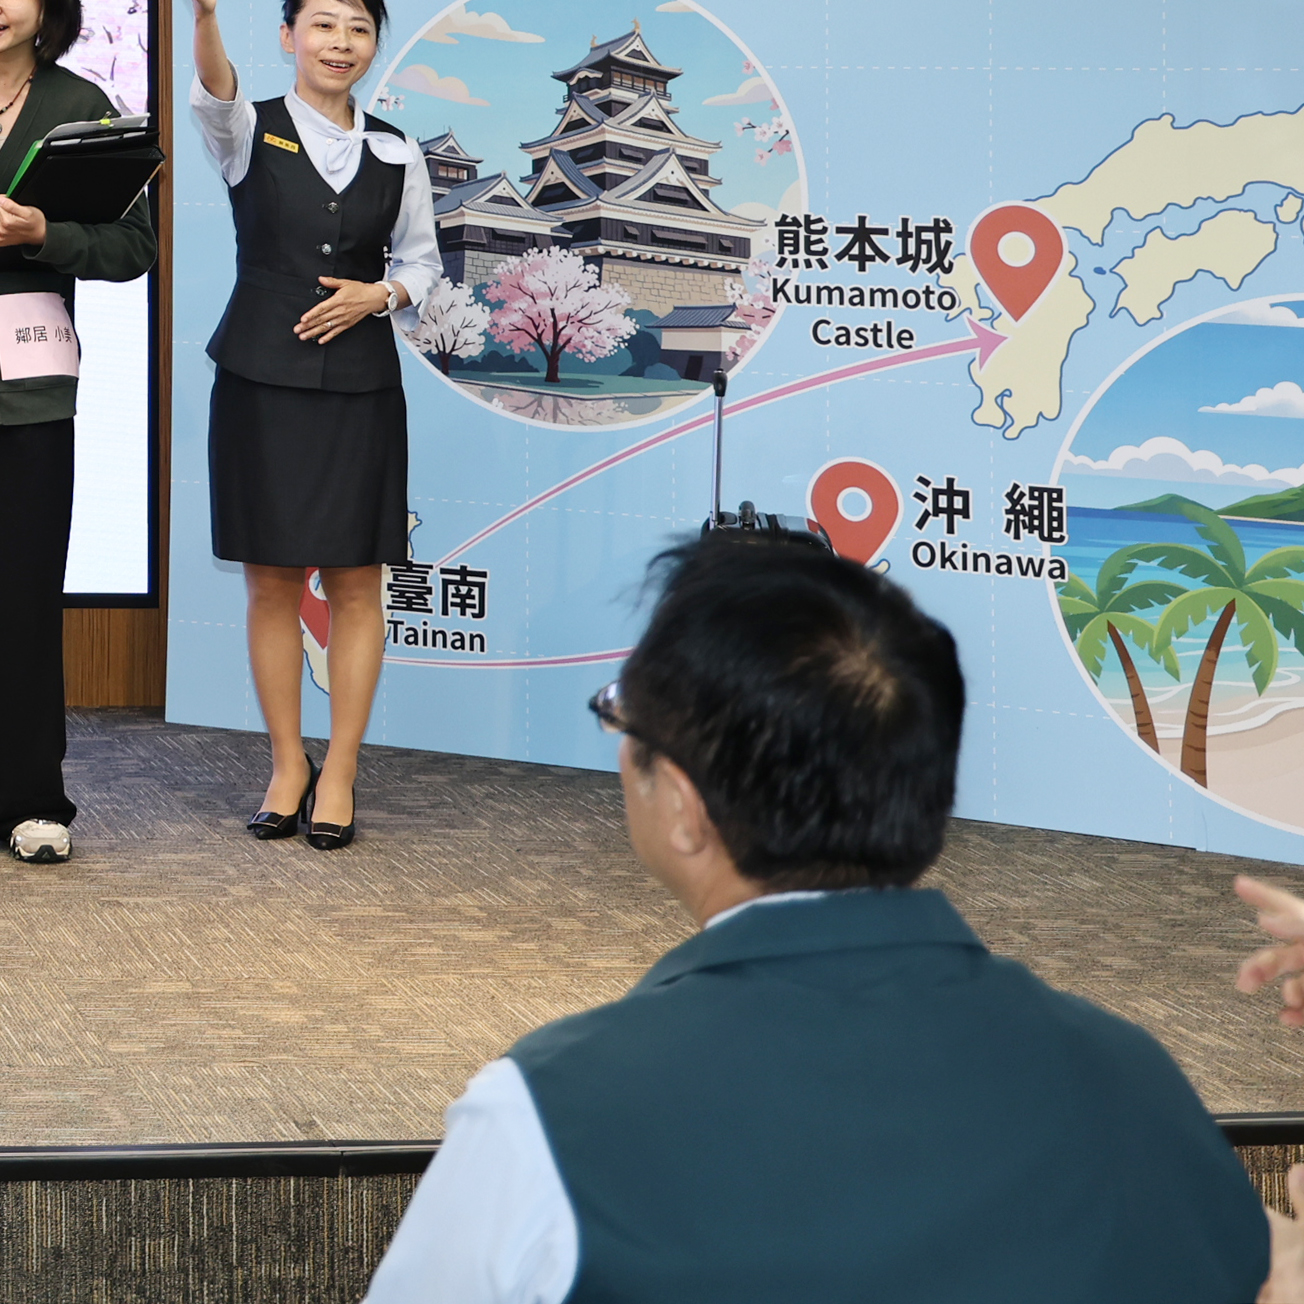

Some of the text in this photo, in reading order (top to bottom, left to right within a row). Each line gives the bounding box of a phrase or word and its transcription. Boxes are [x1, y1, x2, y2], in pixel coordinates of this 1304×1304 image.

[774, 214, 954, 274] 熊本城
[772, 278, 957, 311] Kumamoto
[15, 325, 48, 344] 鄰居
[812, 318, 914, 349] Castle
[912, 541, 1066, 580] Okinawa
[386, 560, 487, 618] 臺南
[387, 619, 485, 652] Tainan
